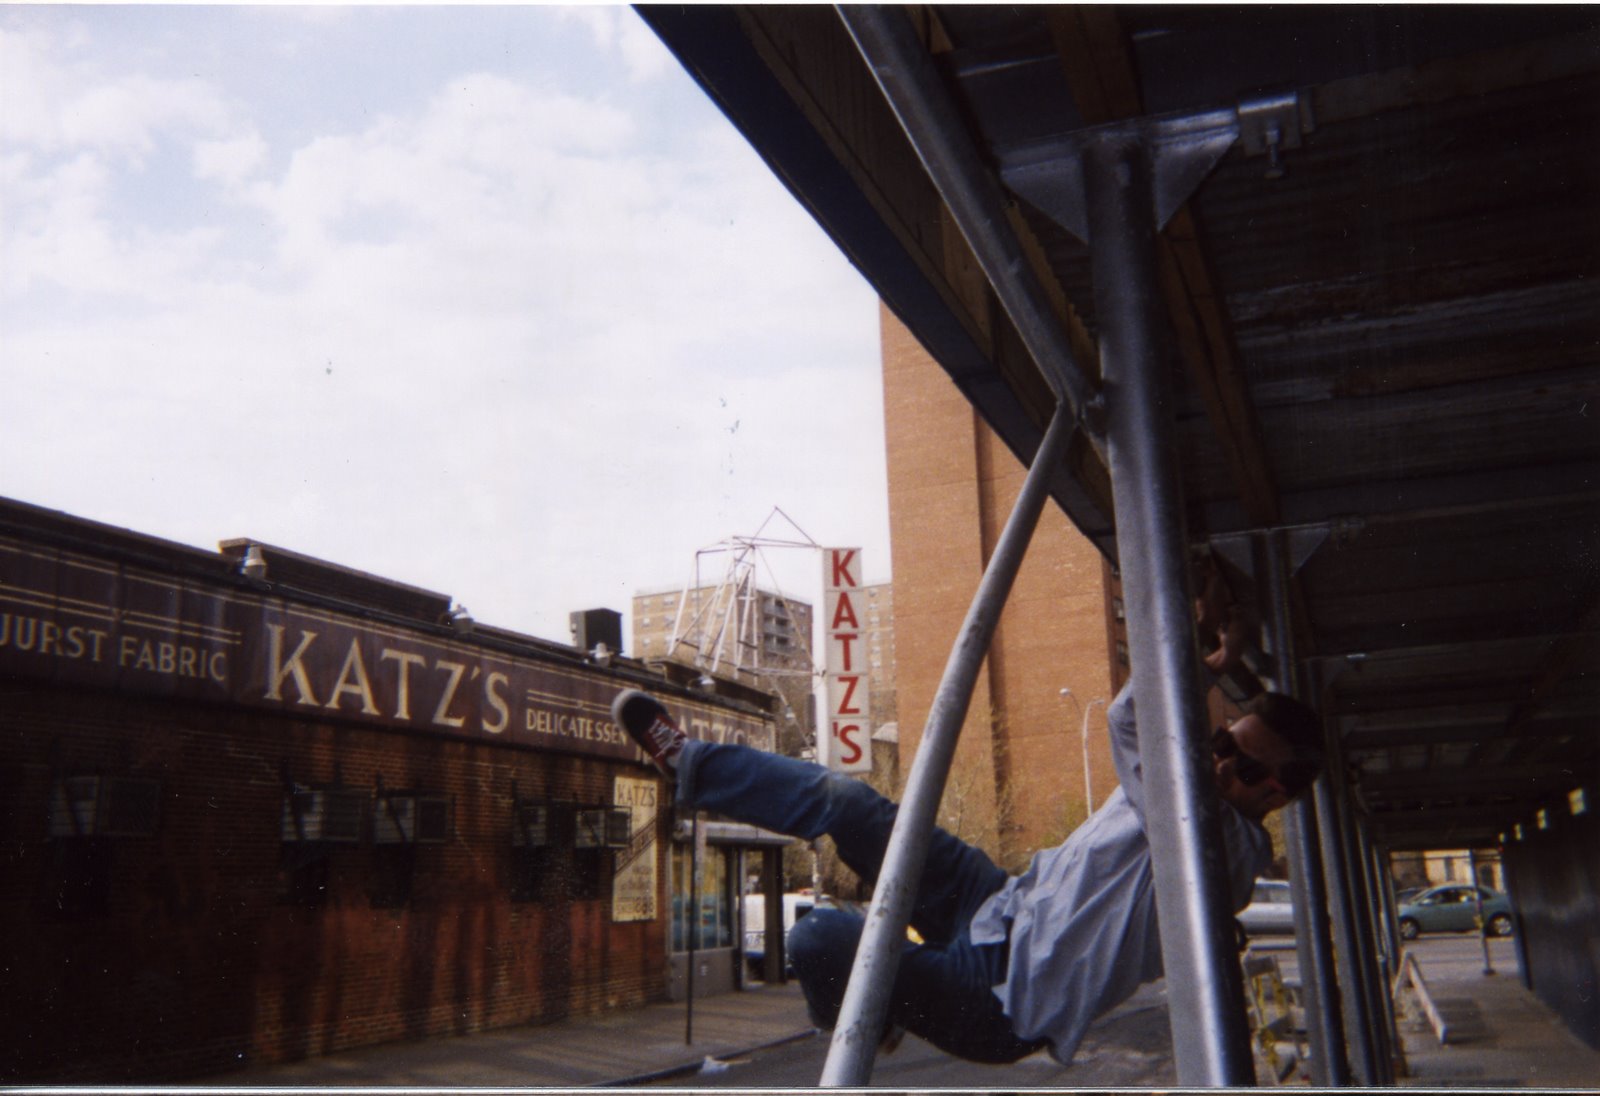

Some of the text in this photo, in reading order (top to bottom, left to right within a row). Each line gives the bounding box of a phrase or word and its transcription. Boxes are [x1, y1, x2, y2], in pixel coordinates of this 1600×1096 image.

[119, 635, 226, 681] FABRIC
[263, 623, 510, 734] KATZ'S
[832, 549, 862, 764] KATZ'S
